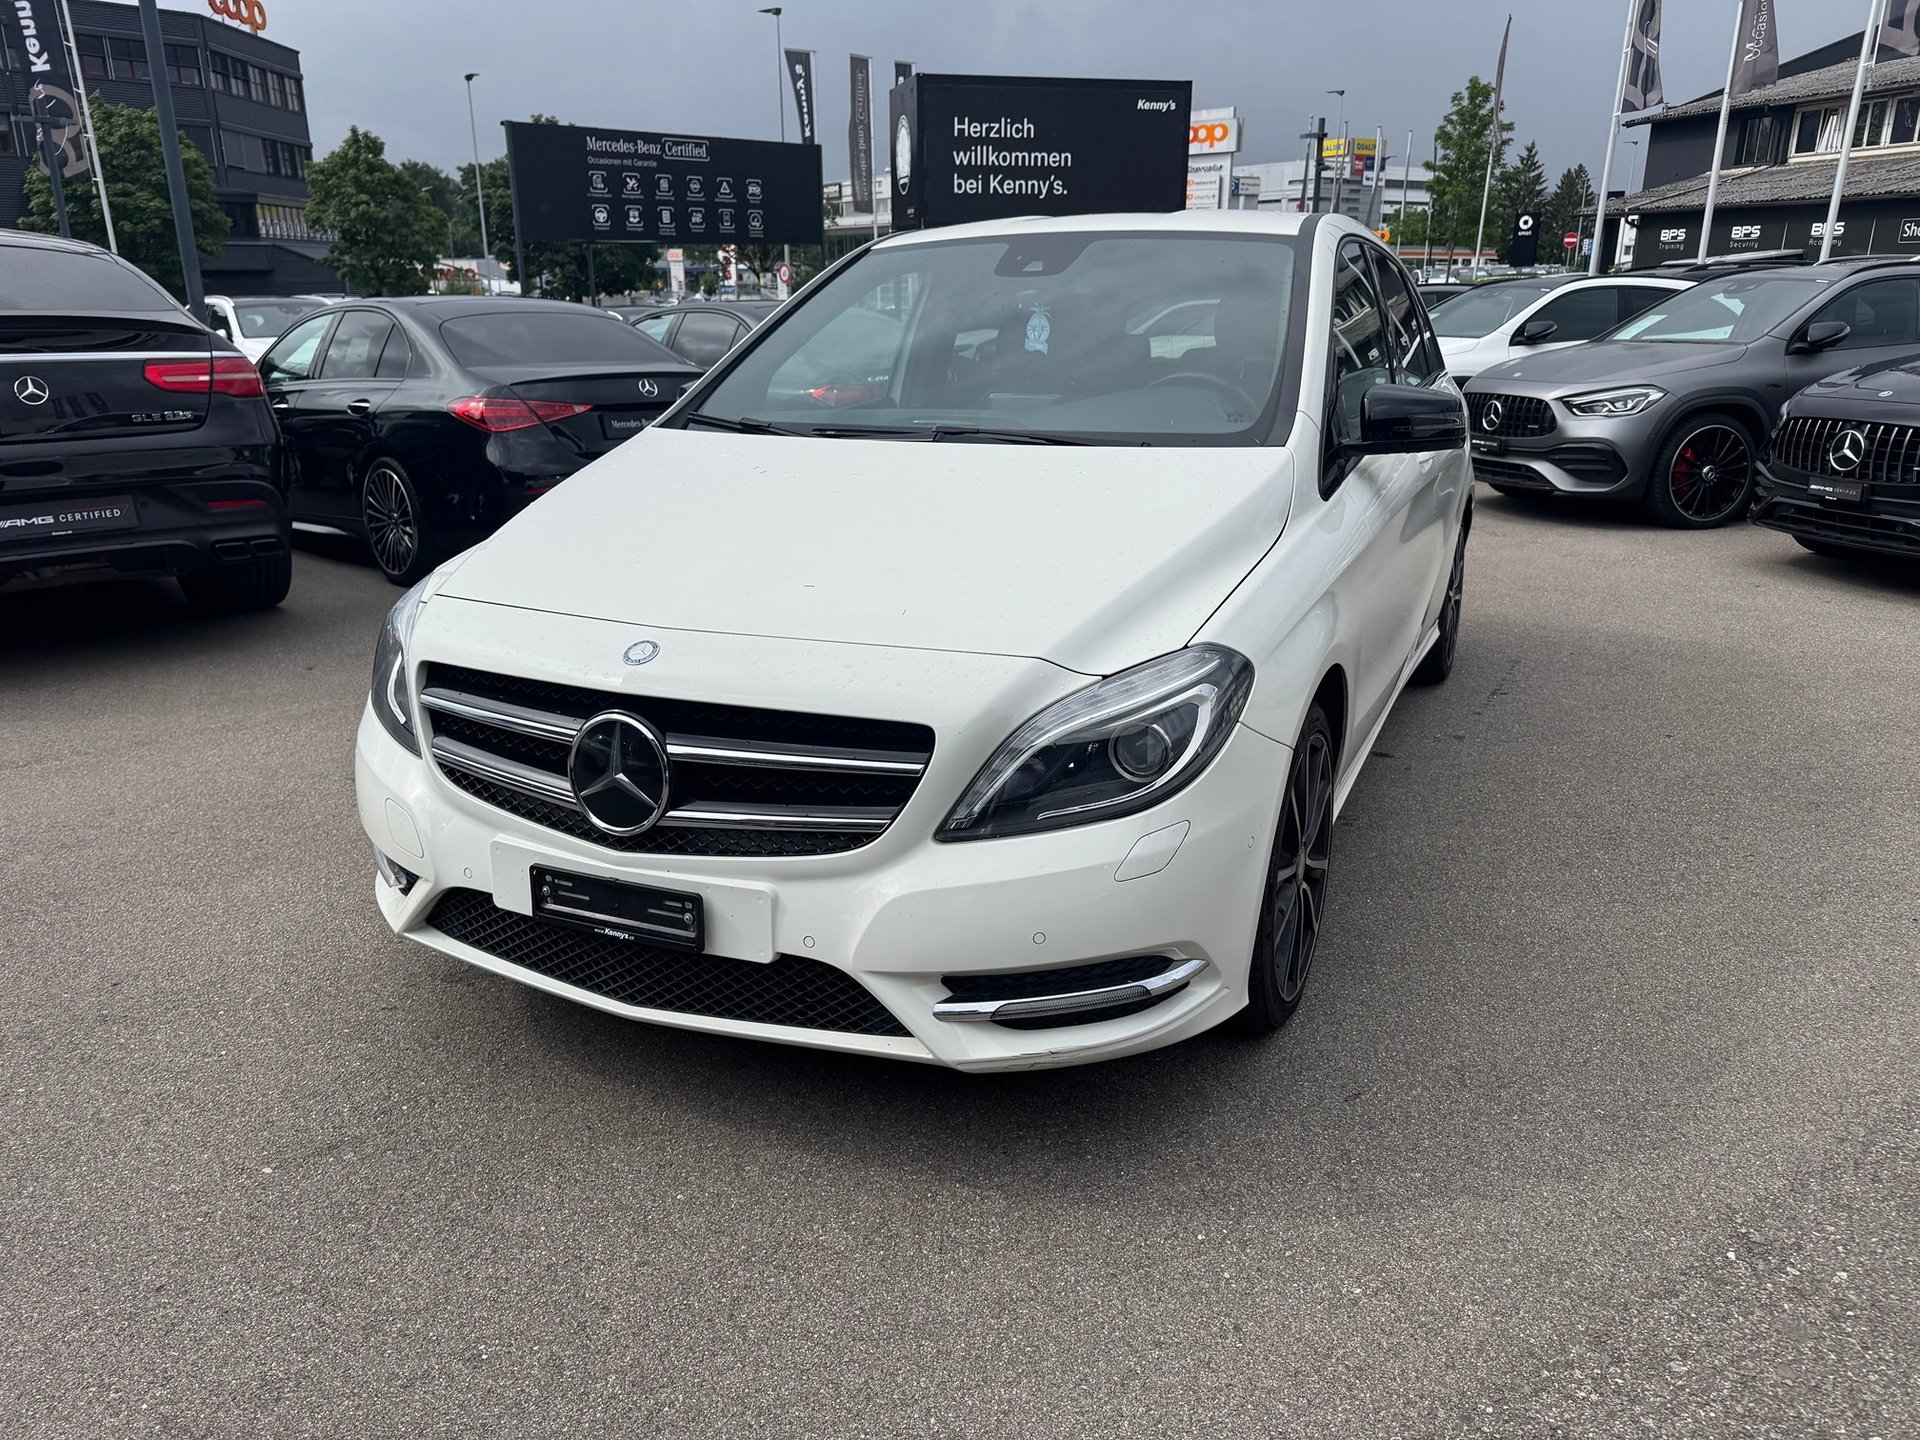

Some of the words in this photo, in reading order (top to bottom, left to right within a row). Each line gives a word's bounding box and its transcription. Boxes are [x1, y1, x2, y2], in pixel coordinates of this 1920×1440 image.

[1751, 0, 1768, 60] Occasio
[1137, 99, 1176, 112] Kenny's
[954, 116, 1034, 138] Herzlich
[1190, 123, 1228, 148] oop
[586, 136, 662, 155] Mercedes-Benz
[665, 141, 707, 158] Certified
[587, 155, 622, 166] Occasionen
[623, 158, 633, 166] mit
[633, 159, 658, 168] Garantie
[953, 145, 1072, 167] willkommen
[954, 173, 982, 194] bei
[990, 174, 1068, 199] Kenny's.
[1660, 228, 1686, 241] BPS
[1731, 225, 1761, 238] BPS
[1729, 241, 1759, 249] Security
[1809, 238, 1842, 247] Acamy
[59, 508, 121, 522] CERTIFIED
